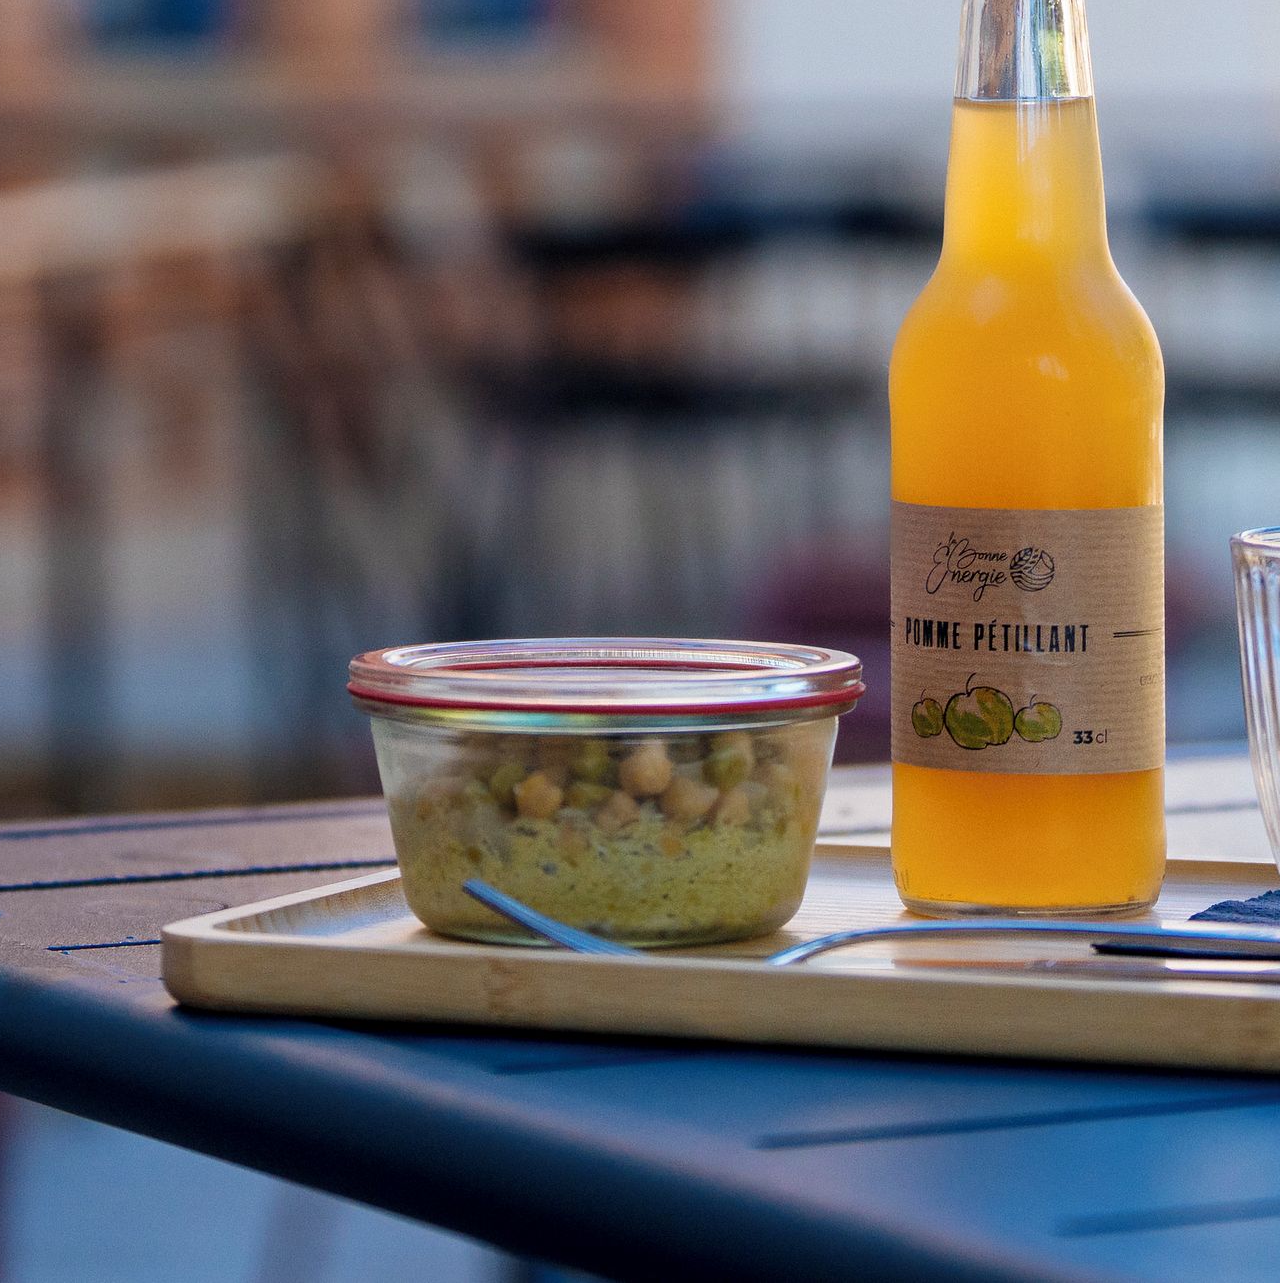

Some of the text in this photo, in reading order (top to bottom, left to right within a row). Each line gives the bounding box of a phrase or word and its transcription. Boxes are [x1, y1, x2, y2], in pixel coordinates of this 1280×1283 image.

[926, 542, 1007, 602] Énergie
[946, 537, 1008, 573] Bonne
[905, 616, 1089, 653] POMME PÉTILLANT
